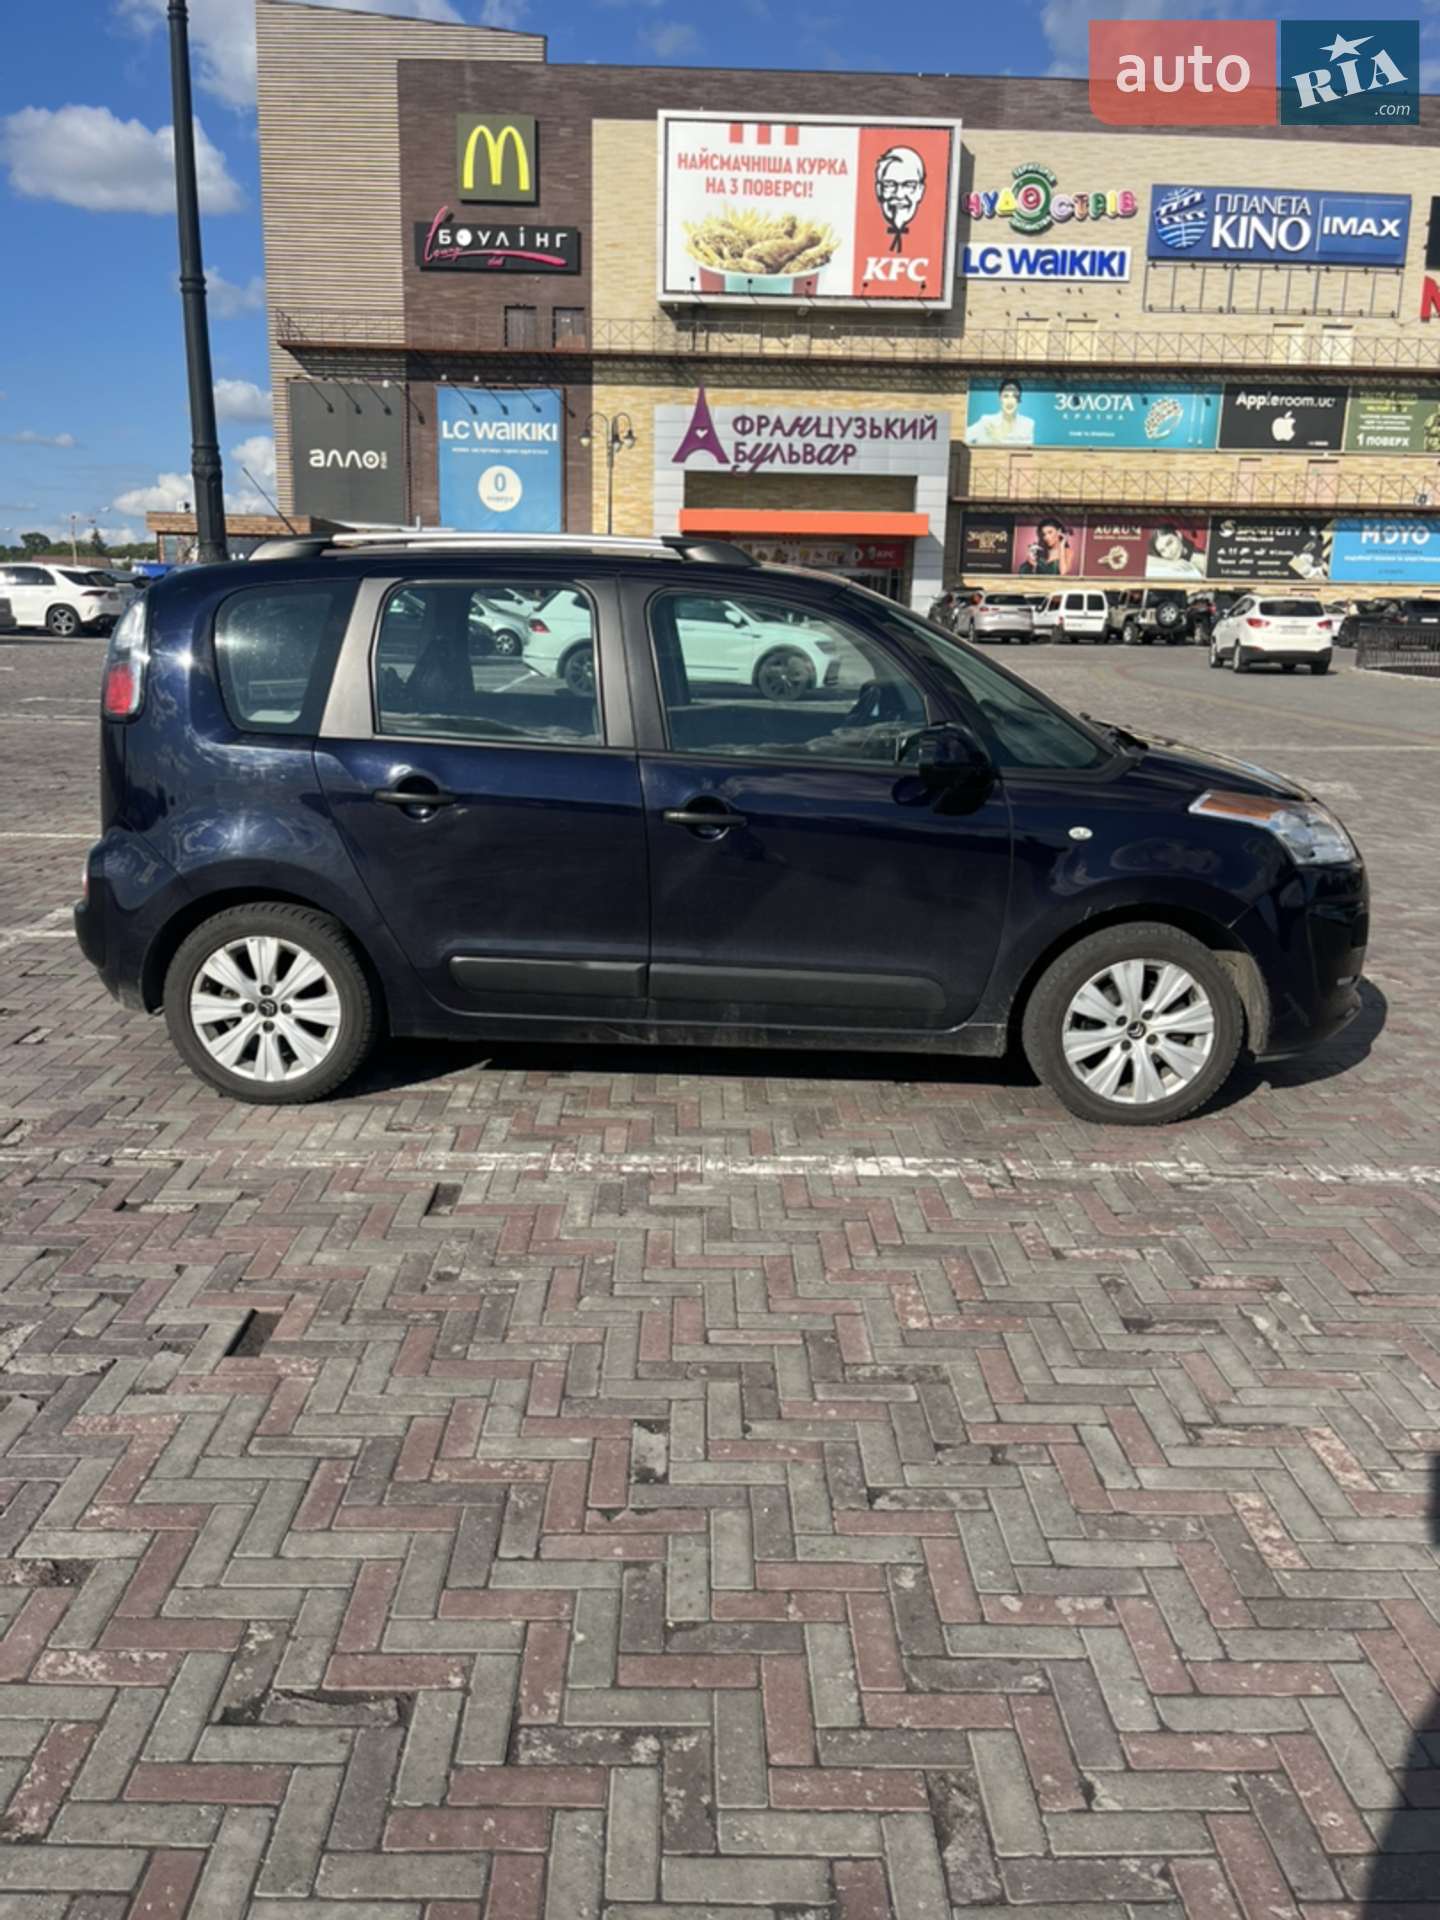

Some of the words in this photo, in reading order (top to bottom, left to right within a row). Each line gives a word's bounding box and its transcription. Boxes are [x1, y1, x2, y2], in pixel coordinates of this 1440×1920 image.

[678, 148, 793, 174] НАЙСМАЧНІША
[796, 157, 848, 176] КУРКА
[705, 177, 726, 195] НА
[729, 178, 738, 195] 3
[742, 179, 813, 198] ПОВЕРСІ!
[1211, 214, 1312, 252] KINO
[1322, 216, 1401, 238] IMAX
[862, 256, 929, 282] KFC
[963, 247, 1002, 275] LC
[1054, 393, 1135, 412] ЗОЛОТА
[441, 420, 470, 439] LC
[732, 414, 938, 440] ФРАНЦУЗЬКИЙ
[1356, 433, 1365, 446] 1
[1366, 436, 1410, 447] ПОВЕРХ
[1361, 526, 1430, 545] MOYO
